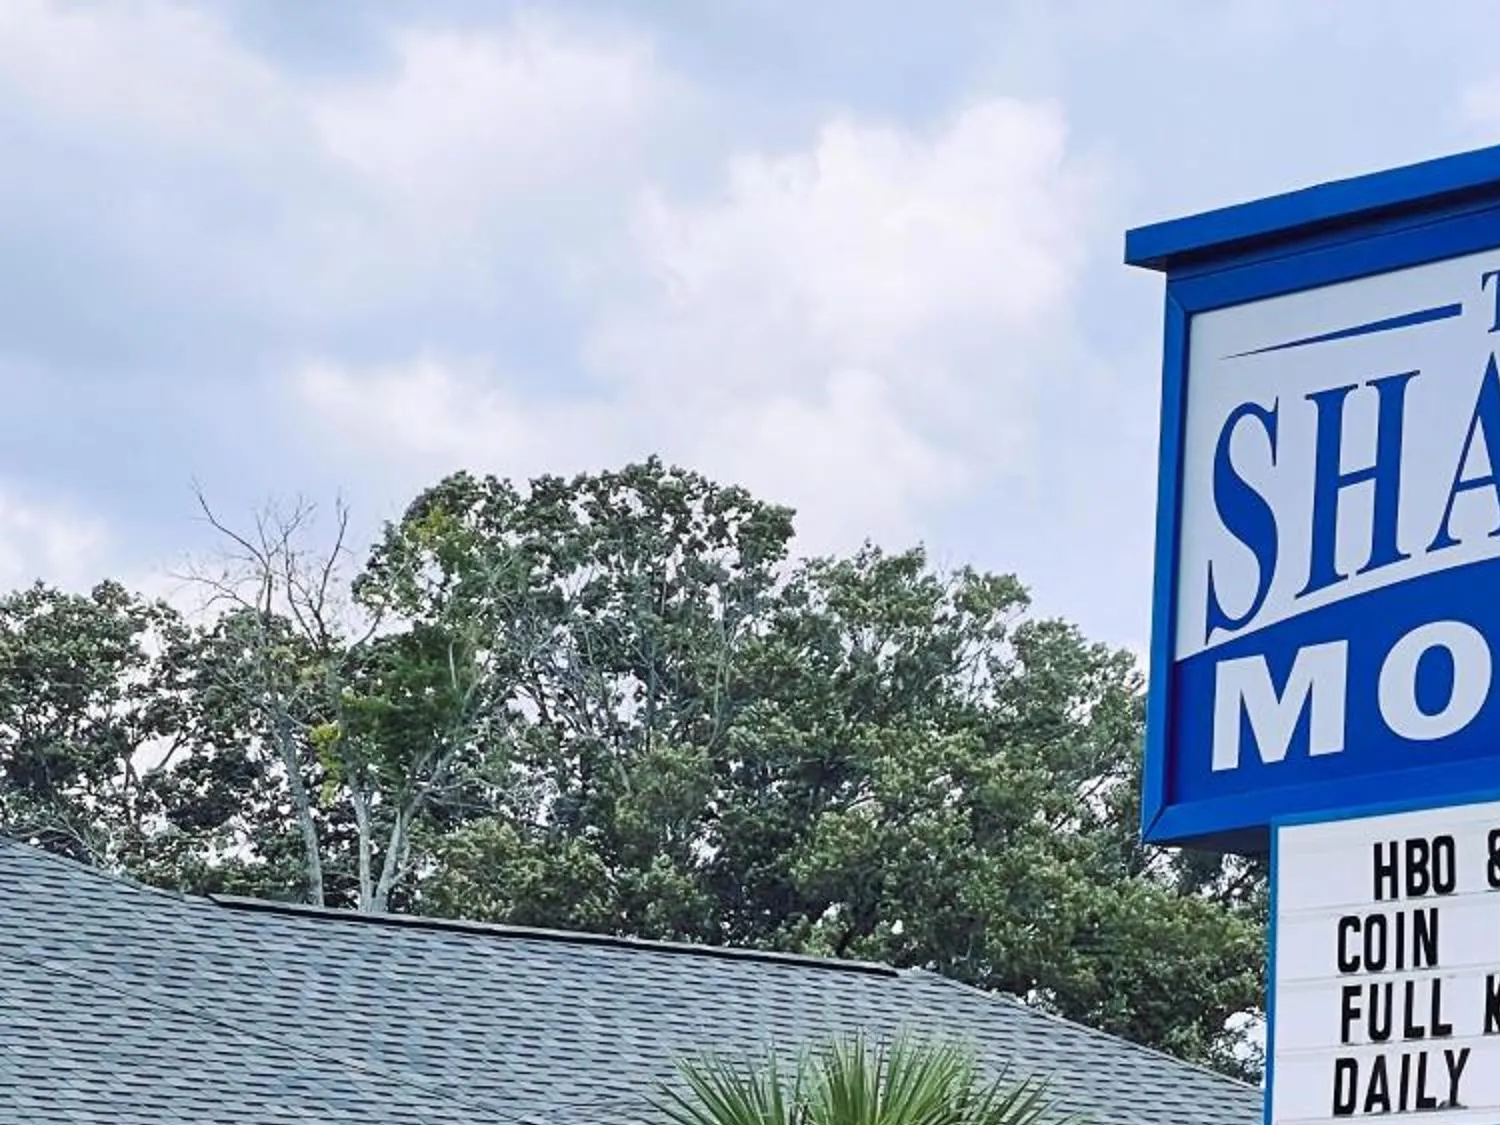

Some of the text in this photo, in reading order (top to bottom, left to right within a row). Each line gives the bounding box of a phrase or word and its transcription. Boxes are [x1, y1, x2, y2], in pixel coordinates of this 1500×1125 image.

[1373, 835, 1456, 901] HBO
[1337, 907, 1439, 974] COIN
[1341, 977, 1453, 1044] FULL
[1333, 1047, 1471, 1117] DAILY
